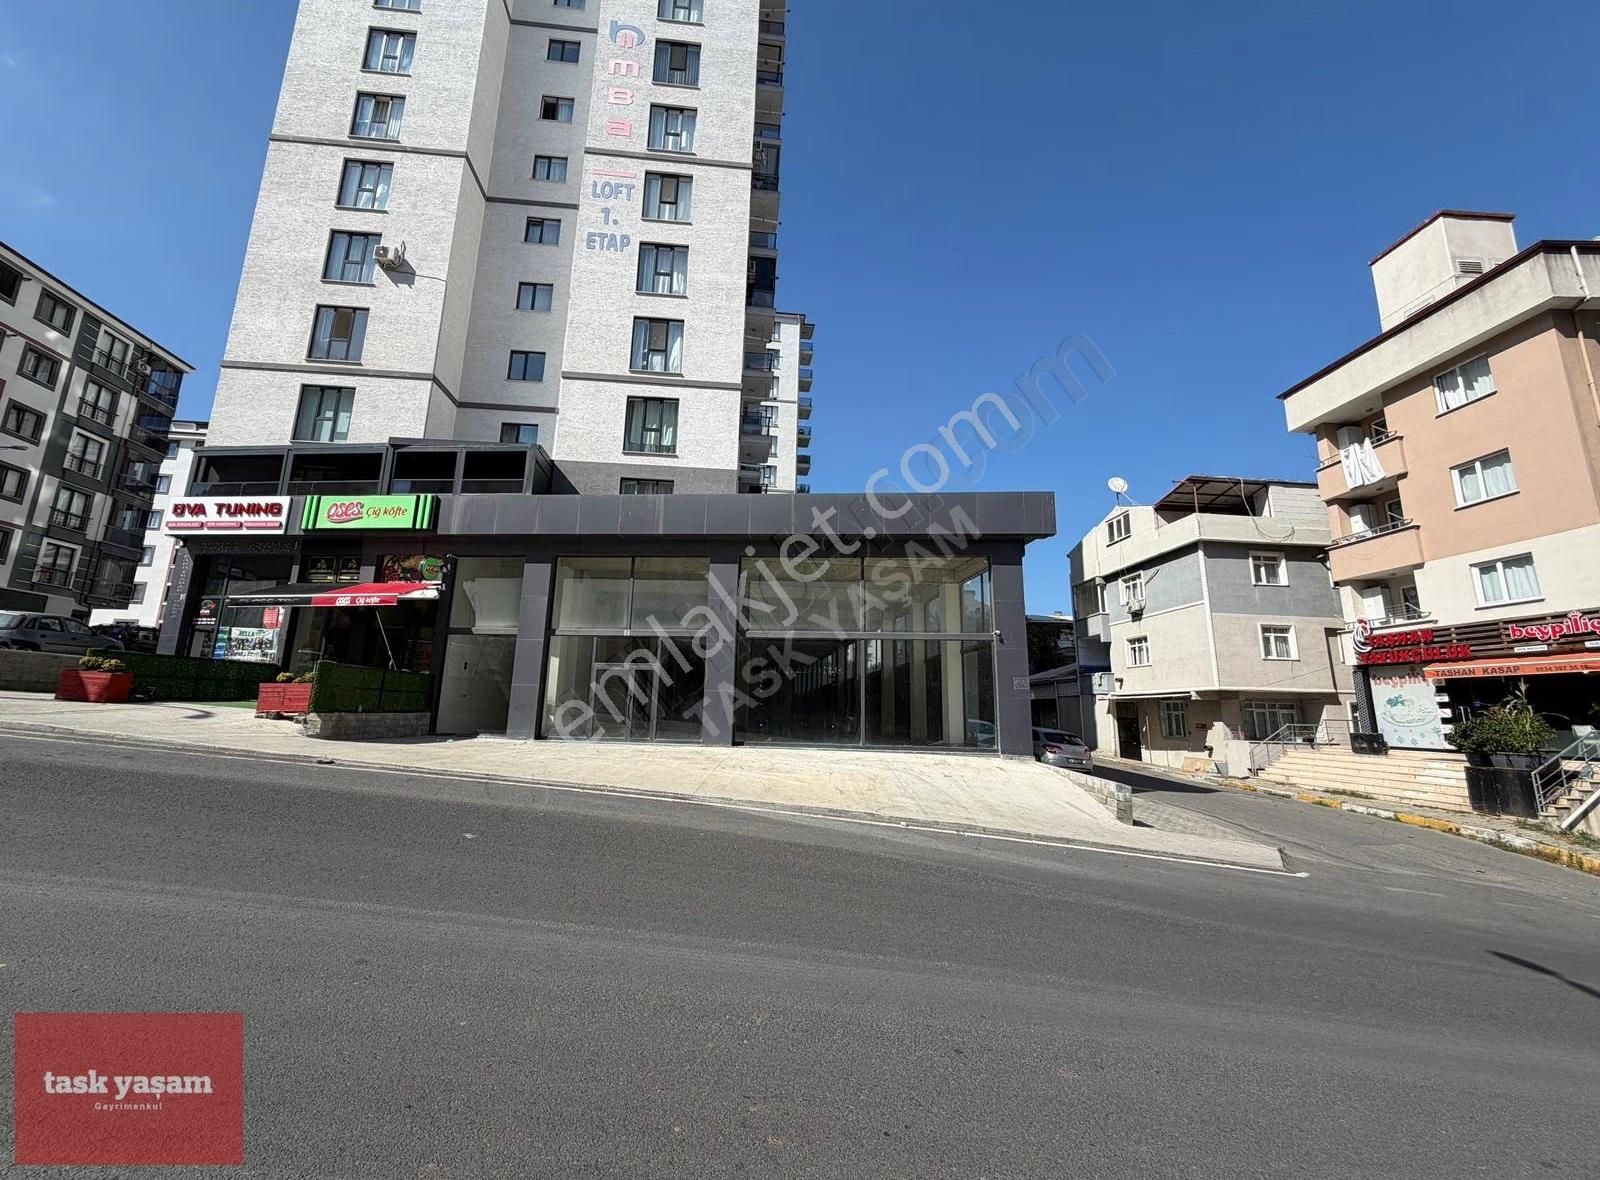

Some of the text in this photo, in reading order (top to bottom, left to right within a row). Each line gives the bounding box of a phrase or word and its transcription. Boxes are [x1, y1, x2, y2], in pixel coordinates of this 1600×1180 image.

[591, 180, 636, 201] LOFT
[601, 207, 619, 225] 1.
[586, 231, 631, 252] ETAP
[216, 502, 283, 519] TUNING
[1482, 665, 1520, 675] KASAP
